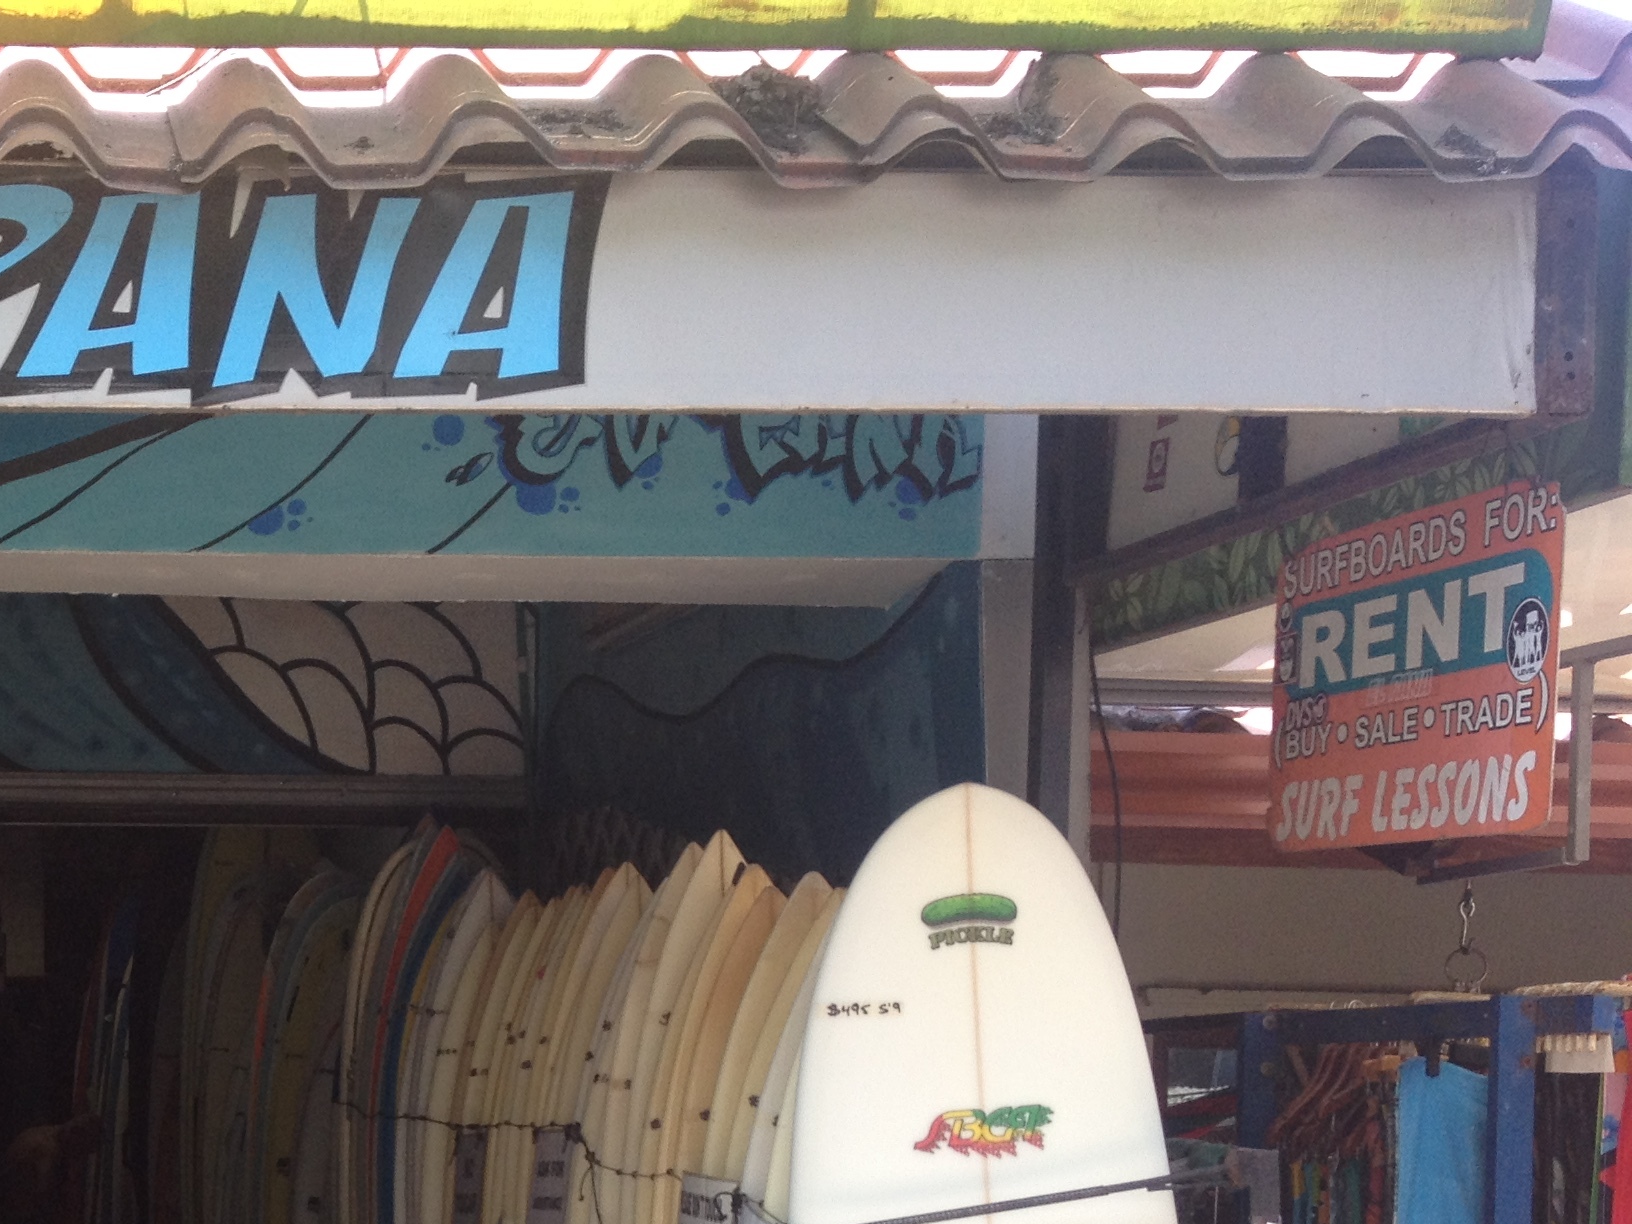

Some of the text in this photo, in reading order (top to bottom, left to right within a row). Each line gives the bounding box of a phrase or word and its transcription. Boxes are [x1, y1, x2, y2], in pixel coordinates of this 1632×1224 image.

[1282, 510, 1466, 597] SURFBOARDS
[1298, 561, 1526, 691] RENT
[1355, 706, 1419, 750] SALE
[1275, 751, 1536, 842] SURF LESSONS
[928, 925, 1014, 950] PICKLE
[827, 1003, 871, 1017] $495
